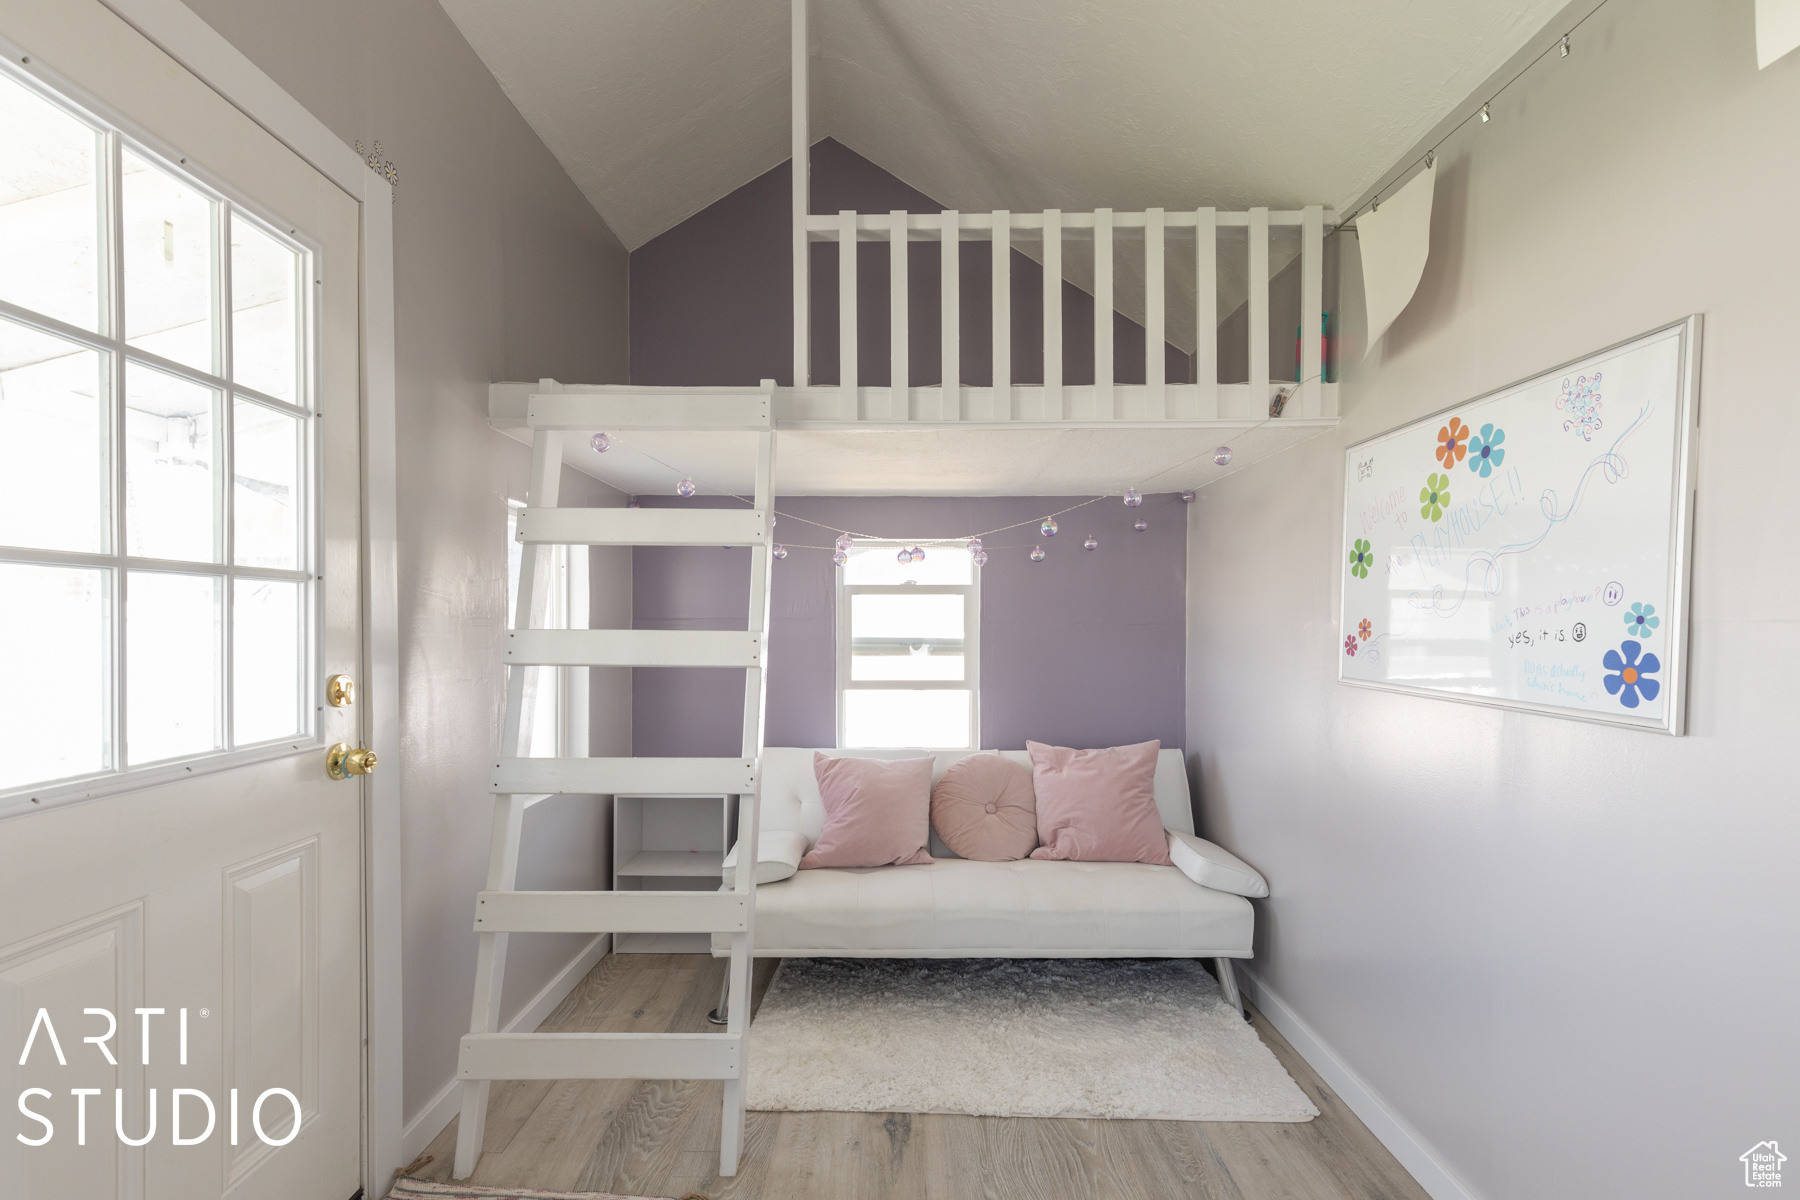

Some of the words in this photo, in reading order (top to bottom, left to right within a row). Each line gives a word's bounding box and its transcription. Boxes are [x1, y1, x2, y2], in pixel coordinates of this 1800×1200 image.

[1395, 511, 1408, 531] to
[1508, 629, 1535, 649] yes,
[1539, 629, 1549, 641] it
